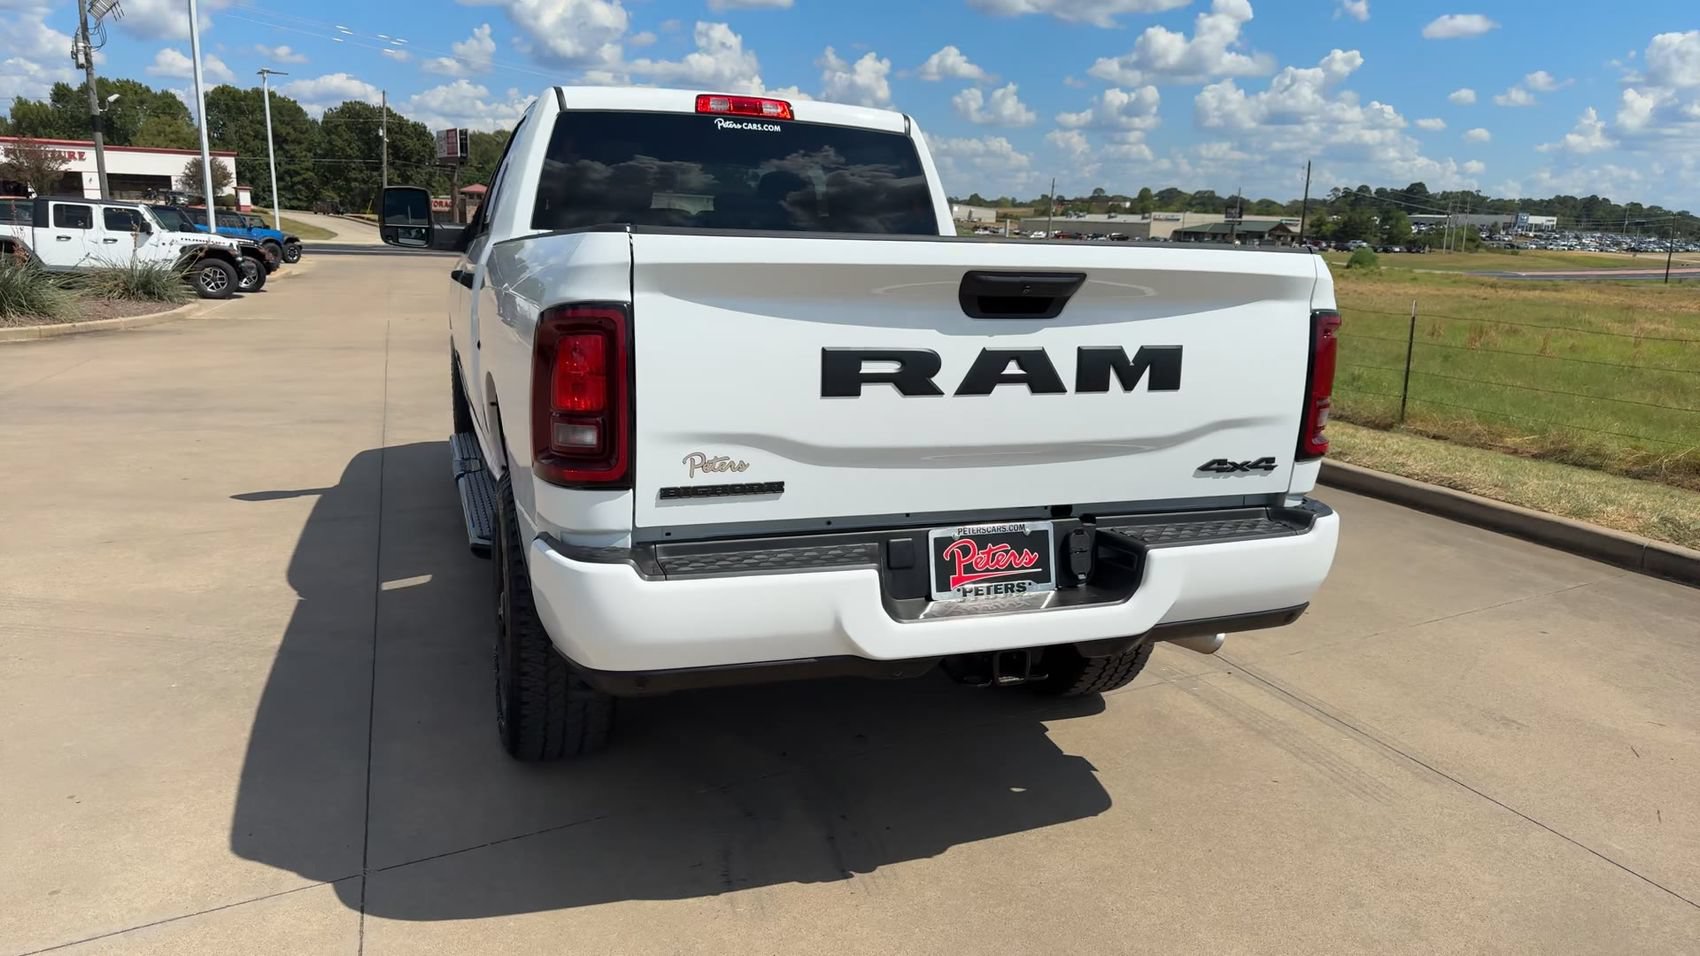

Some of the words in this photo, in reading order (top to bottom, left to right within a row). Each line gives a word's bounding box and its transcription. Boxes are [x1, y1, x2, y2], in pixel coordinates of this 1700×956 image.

[820, 345, 1183, 398] RAM
[682, 452, 749, 479] Peters
[1197, 456, 1279, 473] 4x4
[957, 523, 1026, 536] PETERSCARS.COM
[943, 538, 1040, 580] Peters
[962, 582, 1027, 597] PETERS
